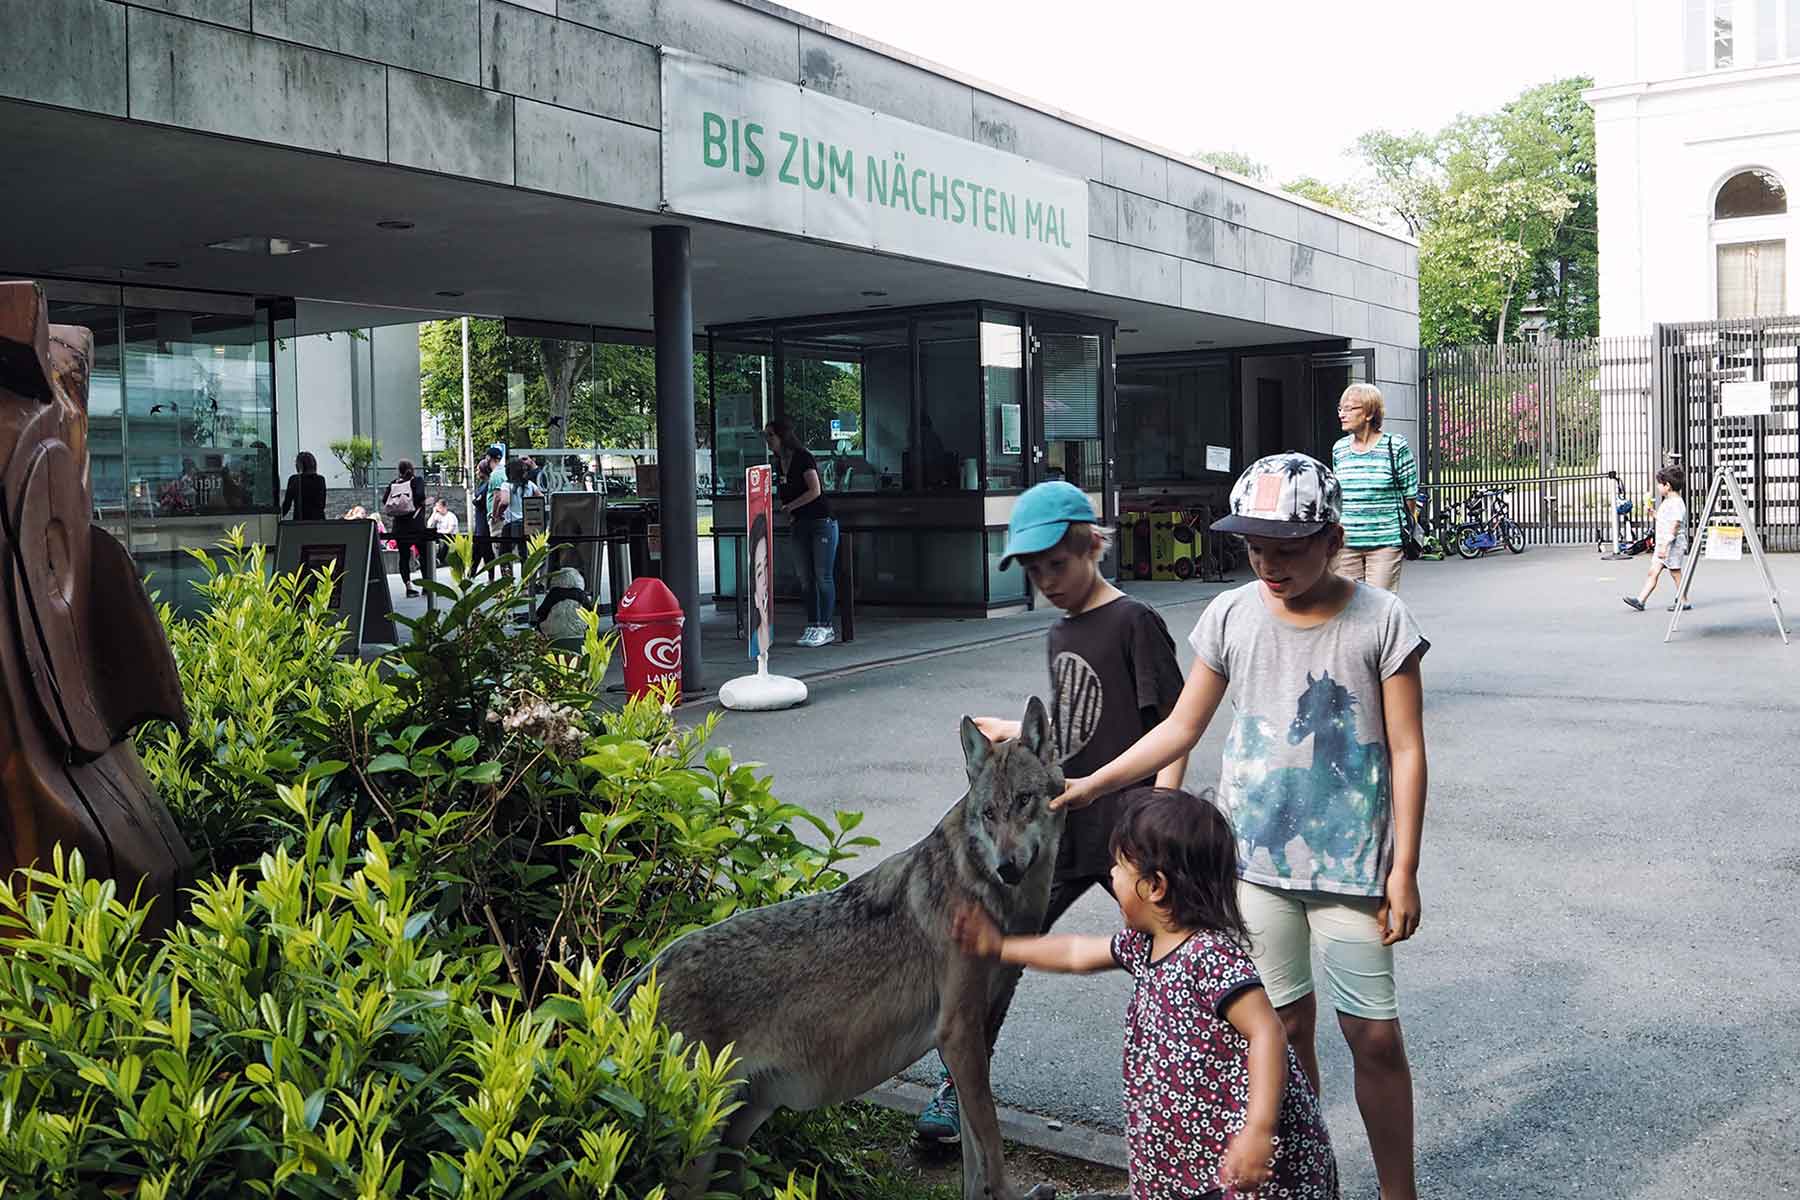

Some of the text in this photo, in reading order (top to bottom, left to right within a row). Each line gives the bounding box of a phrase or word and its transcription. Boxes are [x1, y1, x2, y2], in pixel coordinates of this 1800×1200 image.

[703, 111, 1072, 249] BIS ZUM NÄCHSTEN MAL
